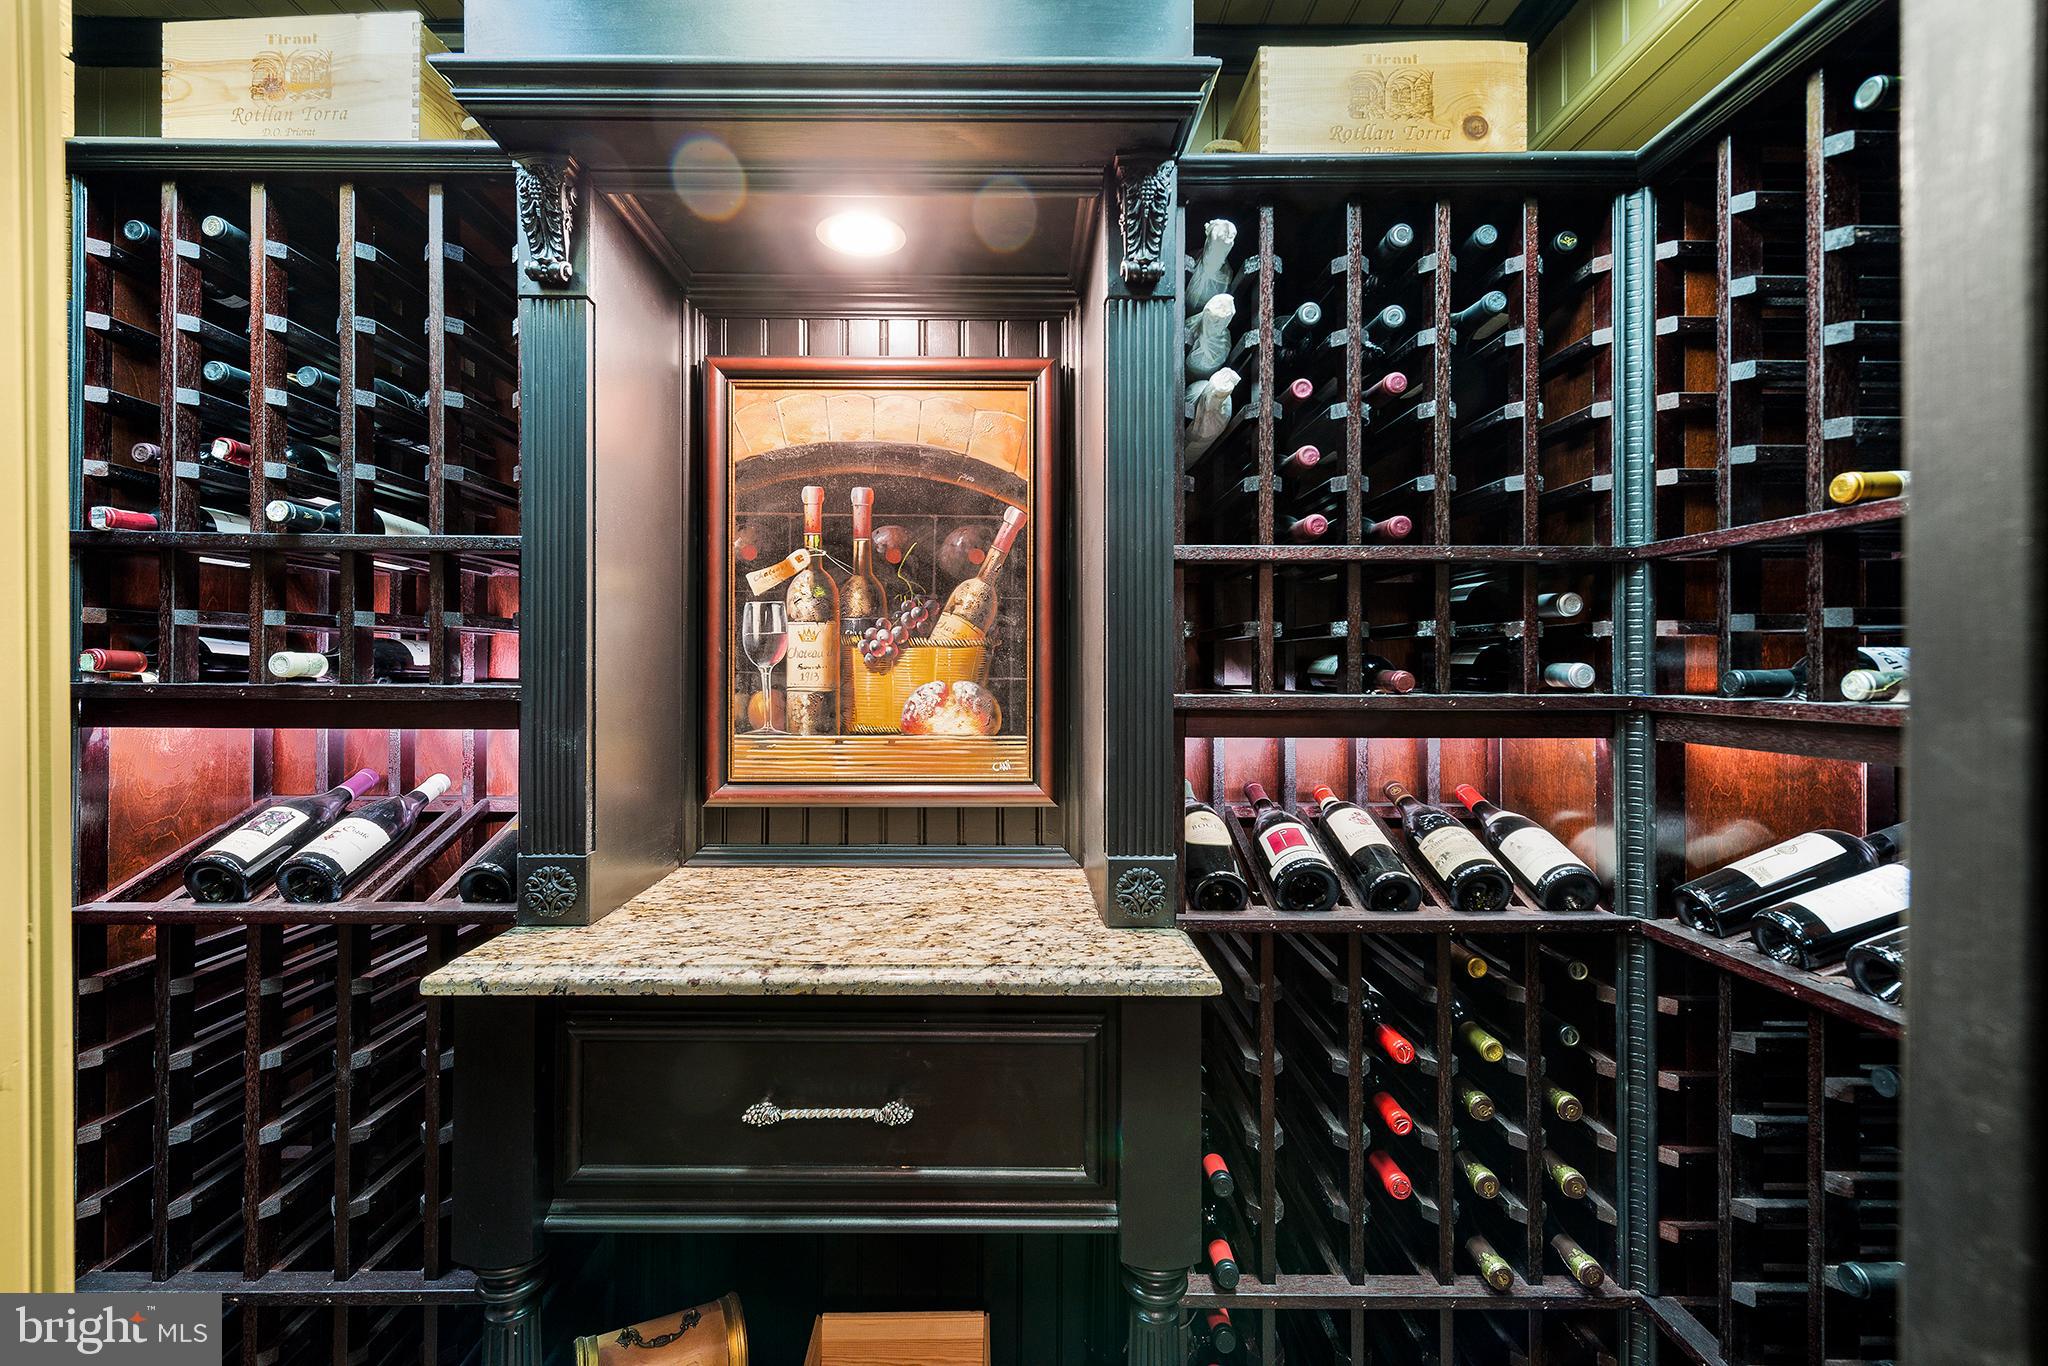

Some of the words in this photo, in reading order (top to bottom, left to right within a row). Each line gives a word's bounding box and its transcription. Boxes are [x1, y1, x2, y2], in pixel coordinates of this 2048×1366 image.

[231, 104, 293, 126] Rotllan
[302, 106, 349, 121] Torra
[1329, 123, 1395, 144] Rotllan
[1404, 125, 1451, 141] Torra
